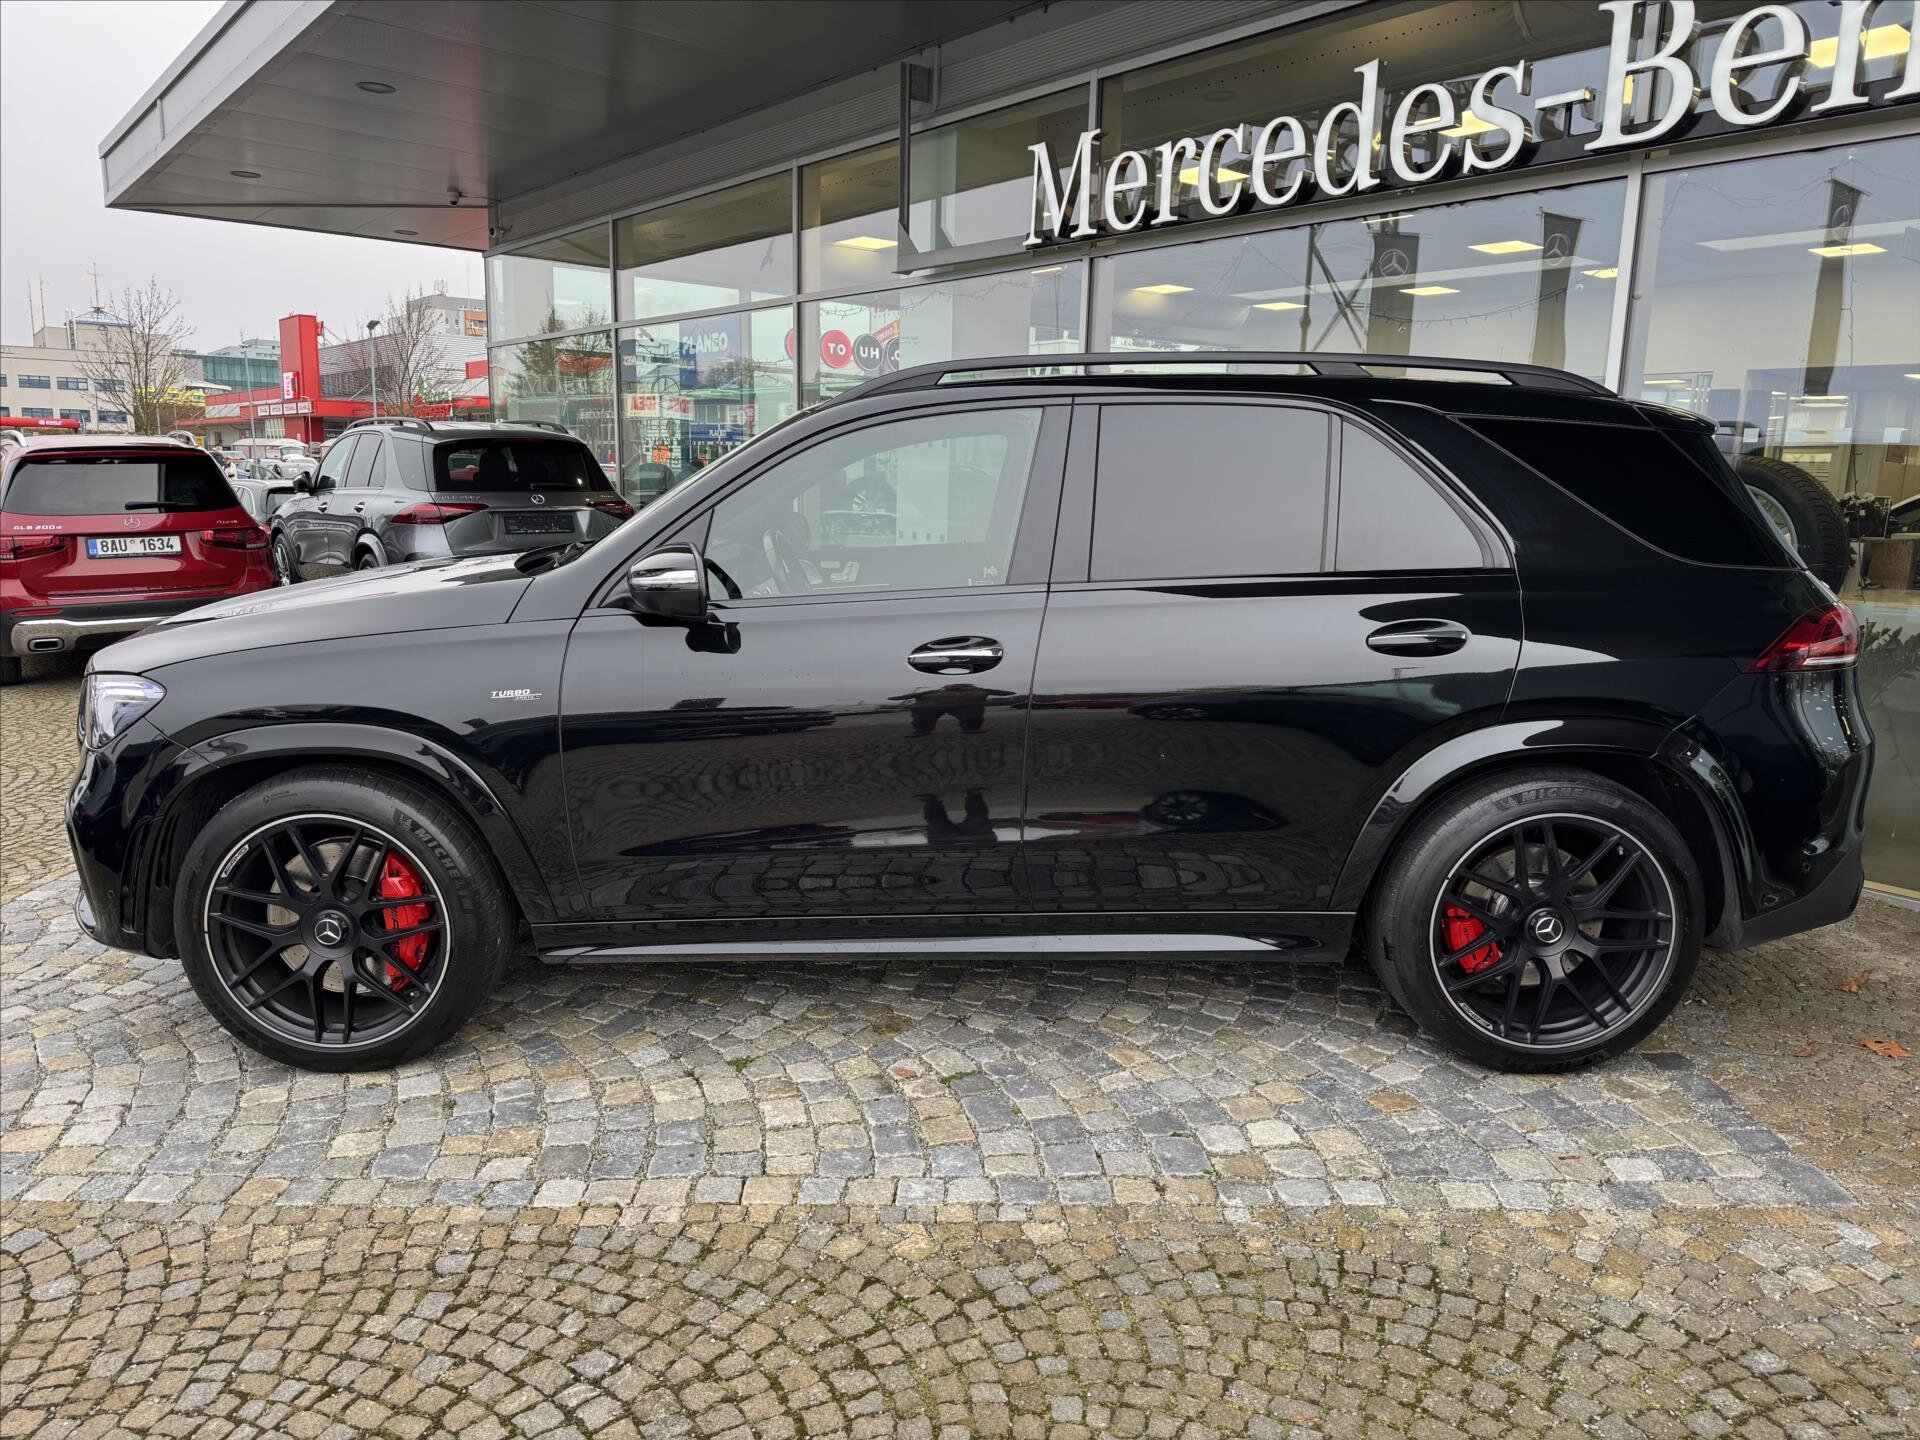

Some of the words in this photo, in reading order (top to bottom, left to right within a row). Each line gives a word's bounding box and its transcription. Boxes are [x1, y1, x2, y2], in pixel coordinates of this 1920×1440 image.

[828, 342, 846, 355] TO
[859, 346, 880, 359] UH
[100, 538, 128, 553] 8AU
[139, 537, 174, 551] 1634
[490, 688, 530, 698] TURBO
